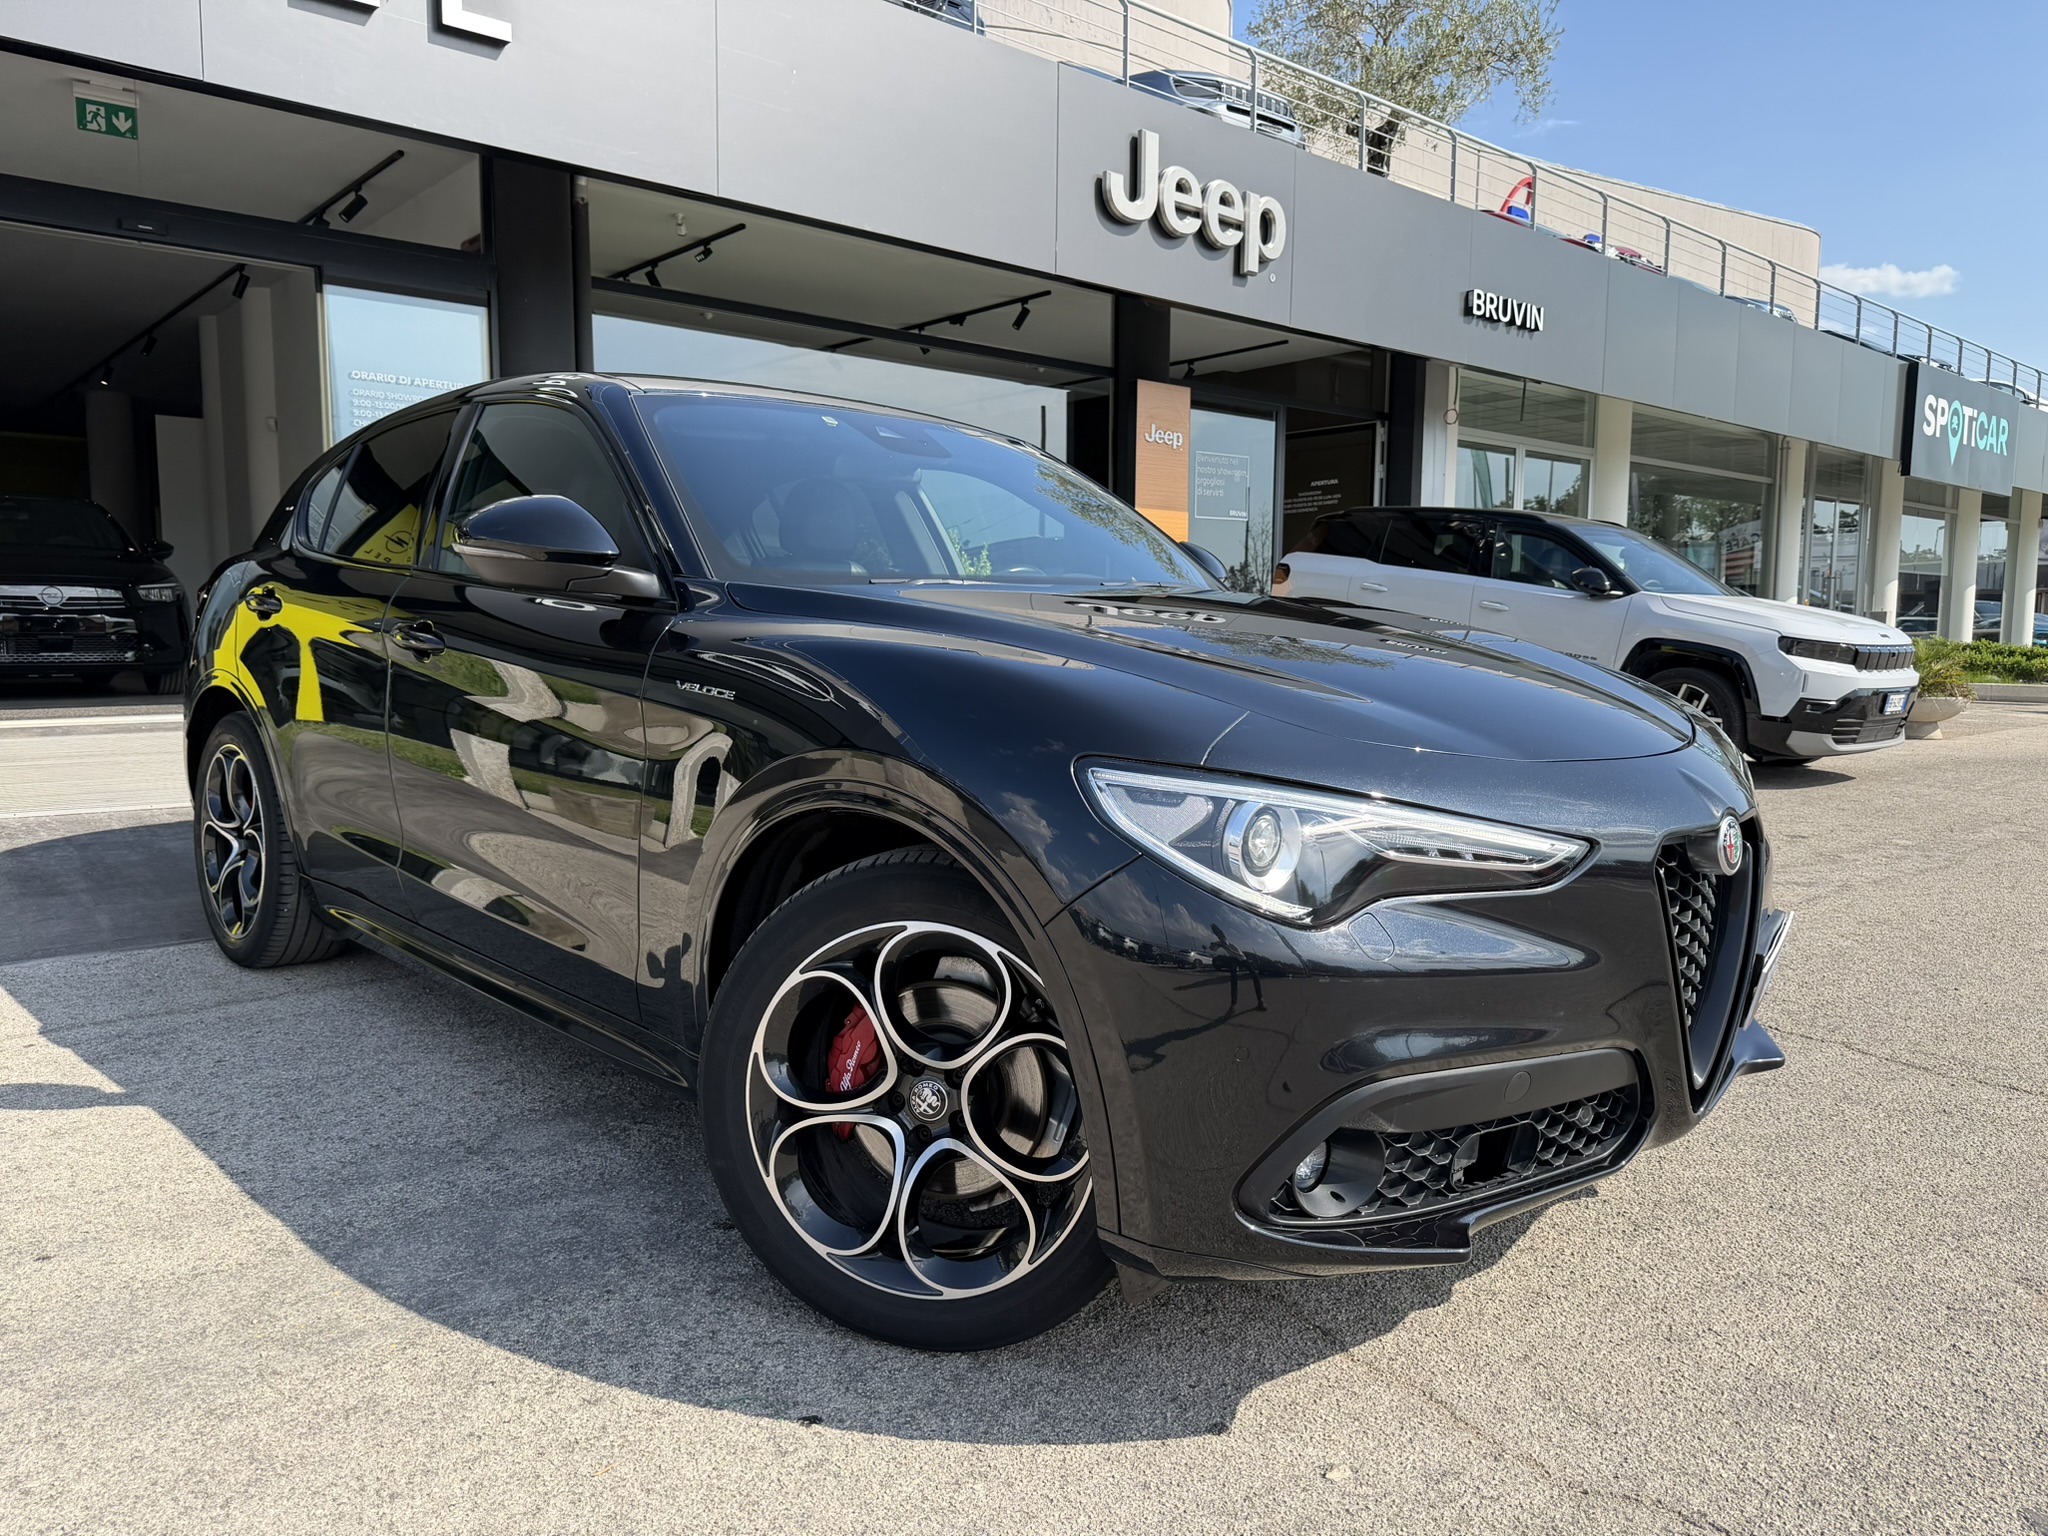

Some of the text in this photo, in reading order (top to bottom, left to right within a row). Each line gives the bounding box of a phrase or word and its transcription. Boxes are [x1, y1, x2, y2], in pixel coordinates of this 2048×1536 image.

[1103, 128, 1287, 277] Jeep
[1472, 288, 1544, 331] BRUVIN
[352, 370, 466, 390] ORARIO DI APERTUR
[352, 389, 385, 398] ORARIO
[1144, 423, 1184, 450] Jeep
[675, 680, 736, 701] VELOCE
[845, 1040, 861, 1072] Romeo
[914, 1083, 939, 1093] ROMEO
